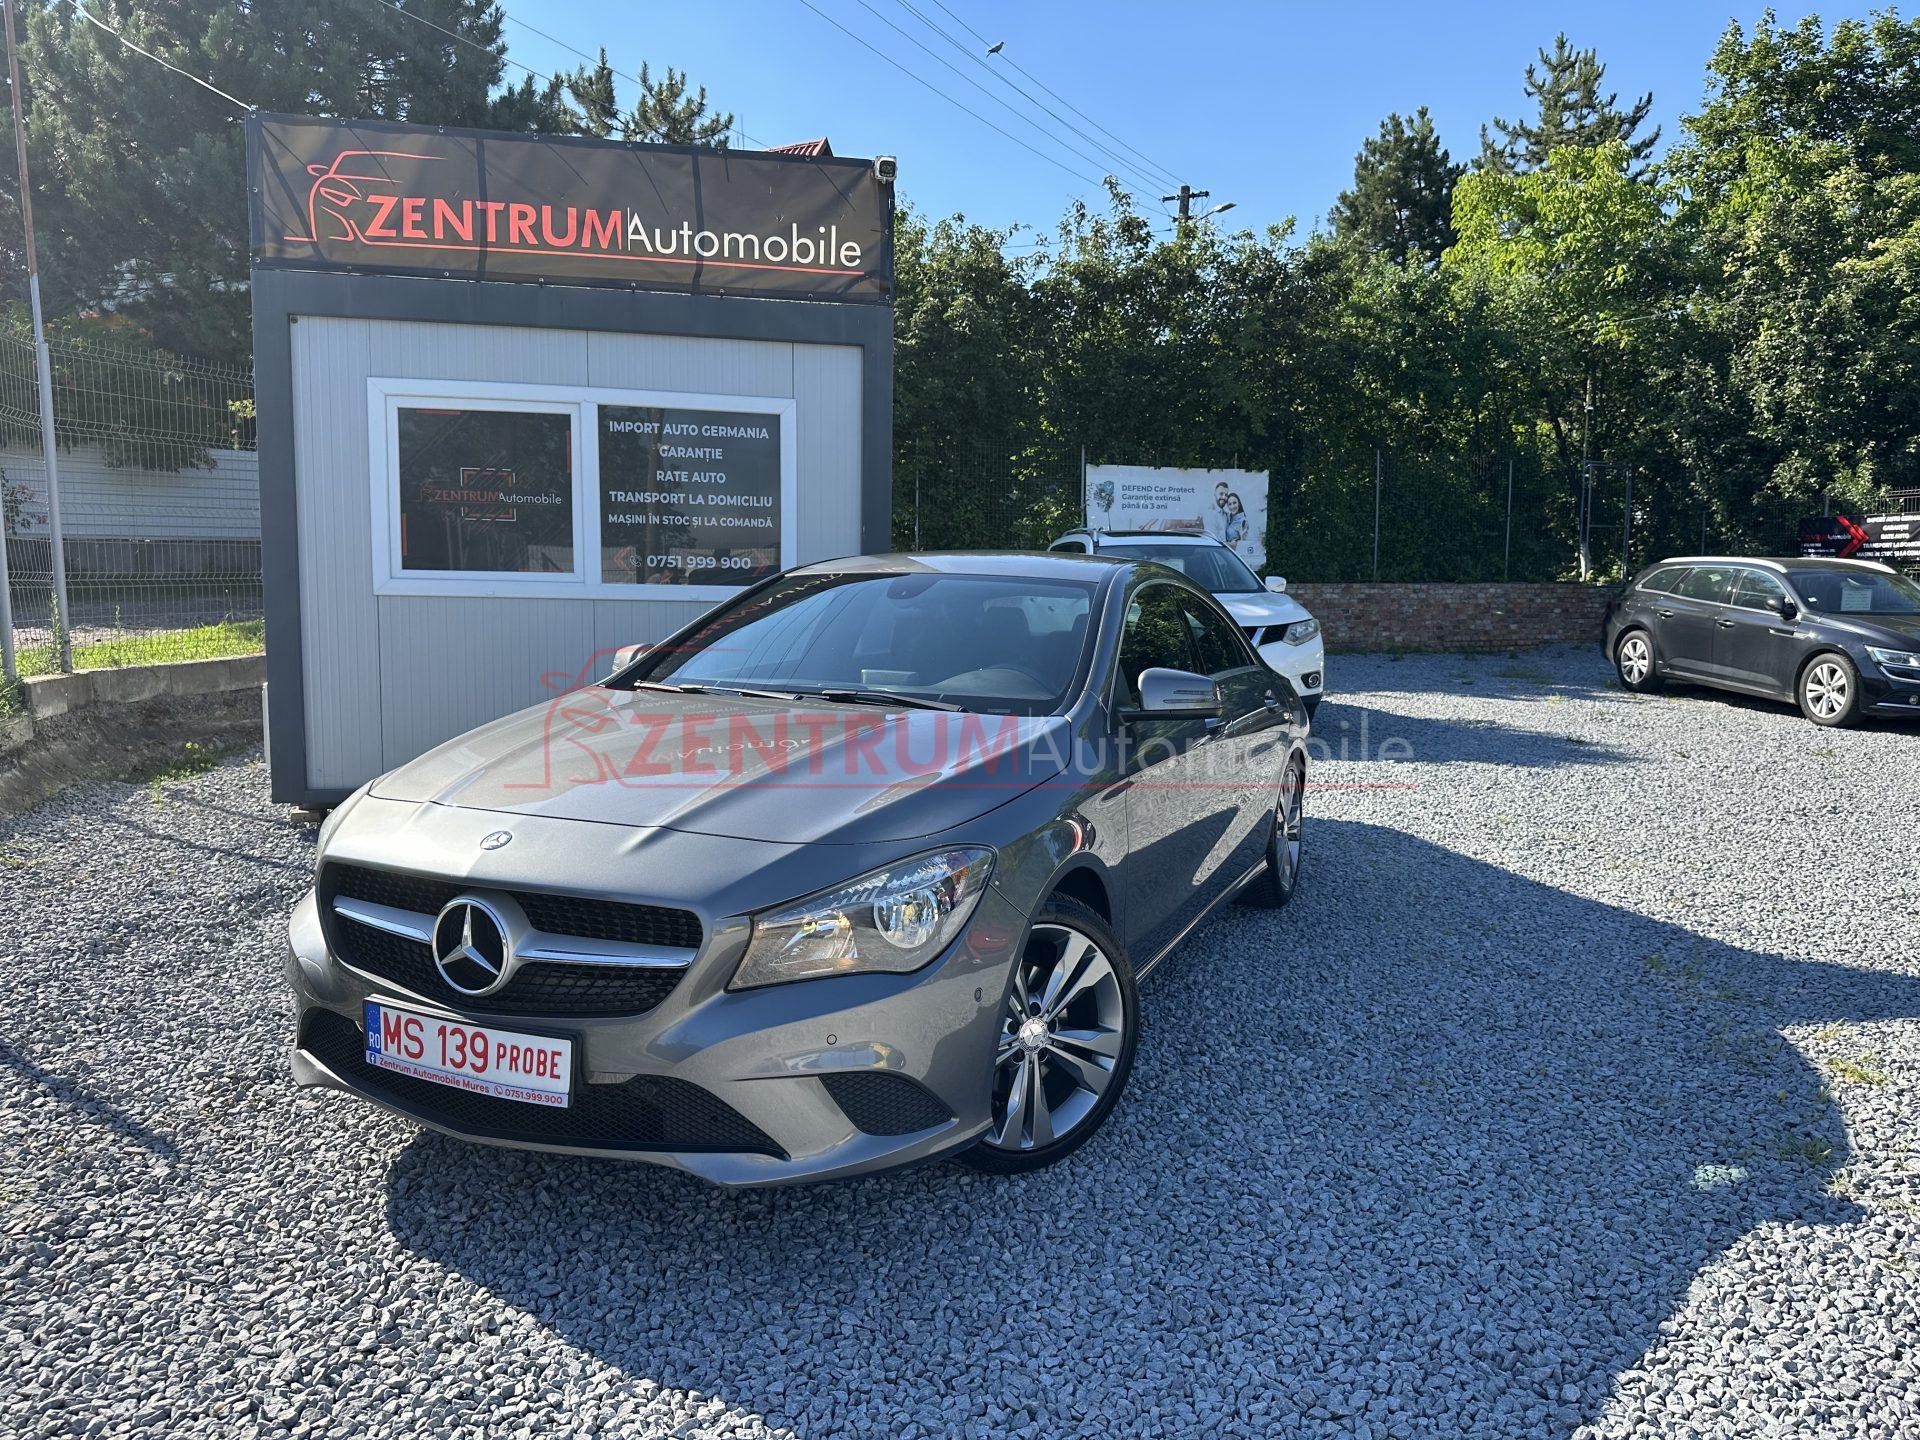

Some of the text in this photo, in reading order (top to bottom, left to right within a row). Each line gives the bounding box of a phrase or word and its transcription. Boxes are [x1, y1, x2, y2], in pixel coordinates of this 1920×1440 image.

[364, 194, 862, 268] ZENTRUM Automobile
[609, 421, 769, 439] IMPORT AUTO GERMANIA
[659, 446, 723, 462] GARANȚIE
[656, 470, 726, 484] RATE AUTO
[434, 489, 562, 505] ZENTRUM Automobile
[609, 491, 773, 507] TRANSPORT LA DOMICILIU
[608, 513, 773, 528] MAȘINI ÎN STOC ȘI LA COMANDĂ
[647, 555, 751, 570] 0751 999 900
[369, 1031, 381, 1049] RO
[383, 1011, 562, 1080] MS 139 PROBE
[379, 1058, 412, 1074] Zentrum
[412, 1067, 461, 1086] Automobile
[462, 1079, 490, 1093] Mures
[505, 1088, 563, 1105] 0751.999.900
